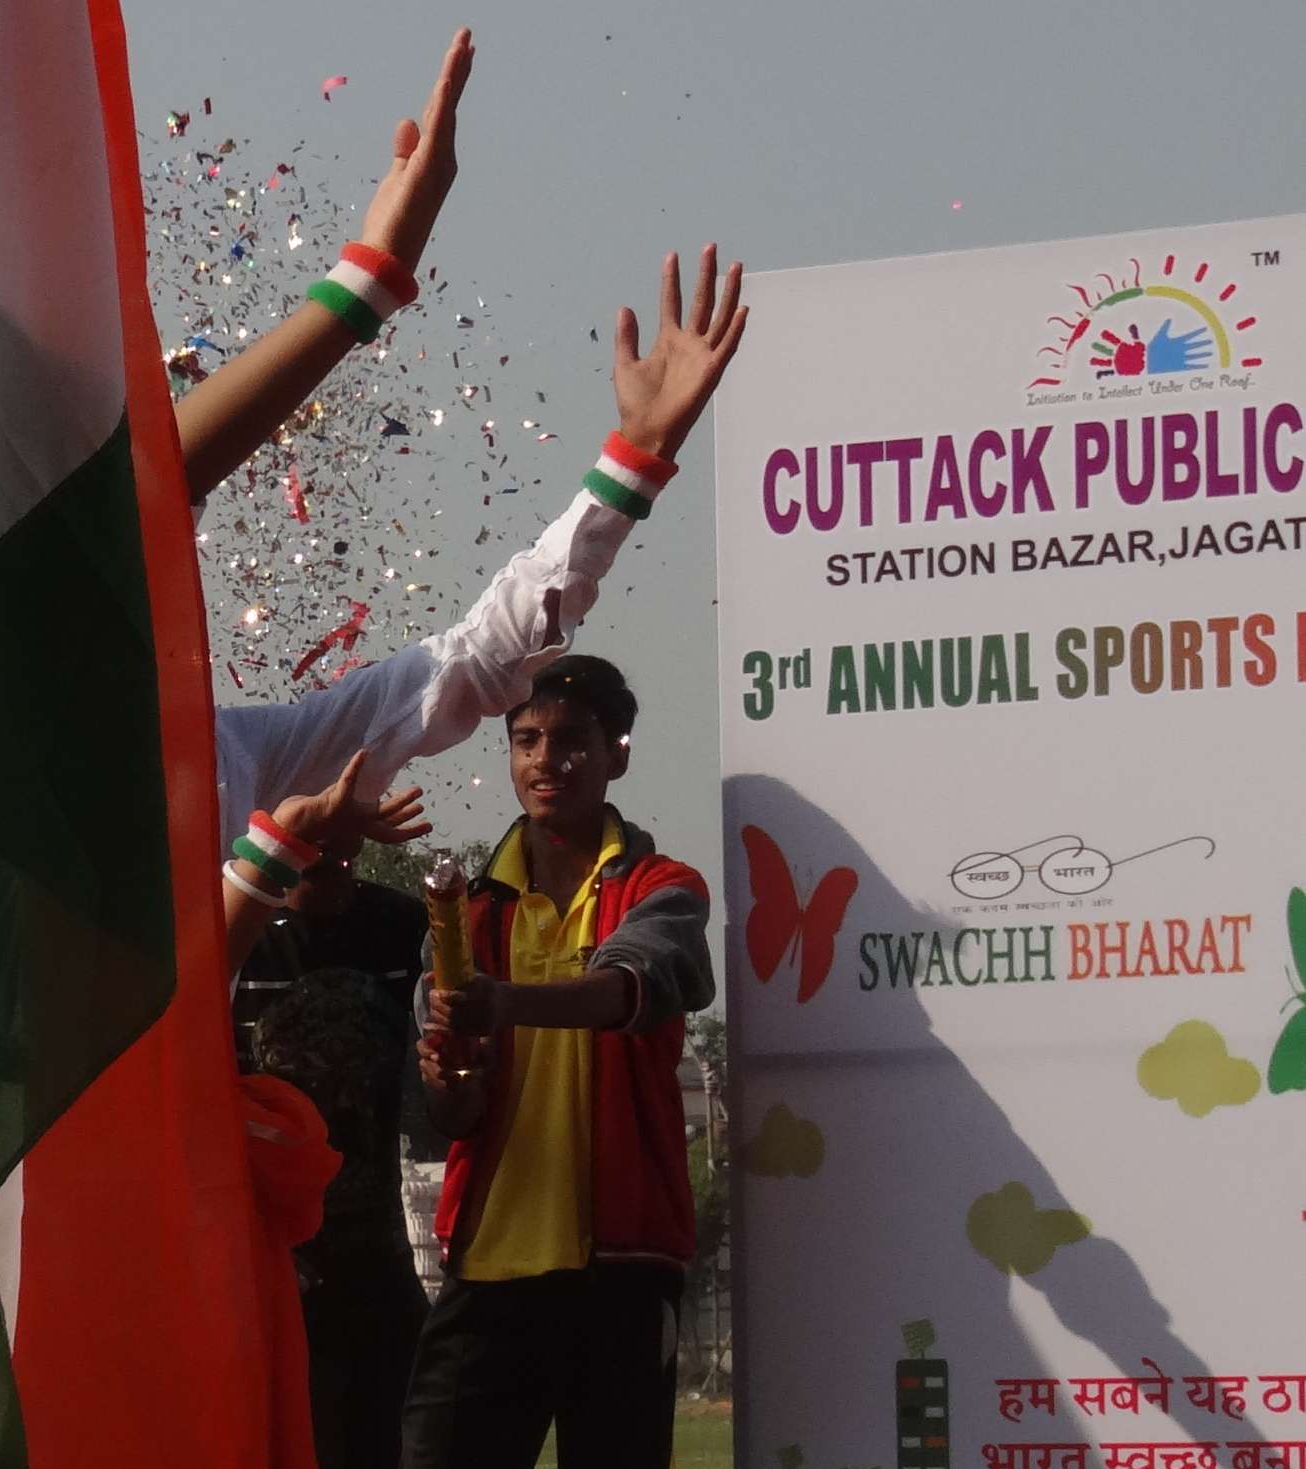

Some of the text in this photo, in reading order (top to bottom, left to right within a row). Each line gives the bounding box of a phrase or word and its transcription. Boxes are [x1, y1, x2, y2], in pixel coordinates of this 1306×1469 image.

[1251, 250, 1281, 267] TM
[1026, 389, 1077, 406] Initiation
[1098, 385, 1144, 400] Intellect
[1147, 379, 1184, 395] Under
[1189, 376, 1214, 391] One
[762, 402, 1305, 535] CUTTACK PUBLIC
[825, 541, 996, 588] STATION
[741, 647, 813, 722] 3rd
[825, 631, 1039, 715] ANNUAL
[1055, 612, 1278, 701] SPORTS
[965, 865, 1096, 884] स्वच्छ भारत
[859, 912, 1253, 993] SWACHH BHARAT
[994, 1378, 1061, 1424] हम
[1067, 1356, 1174, 1417] सबने
[1182, 1375, 1250, 1421] यह
